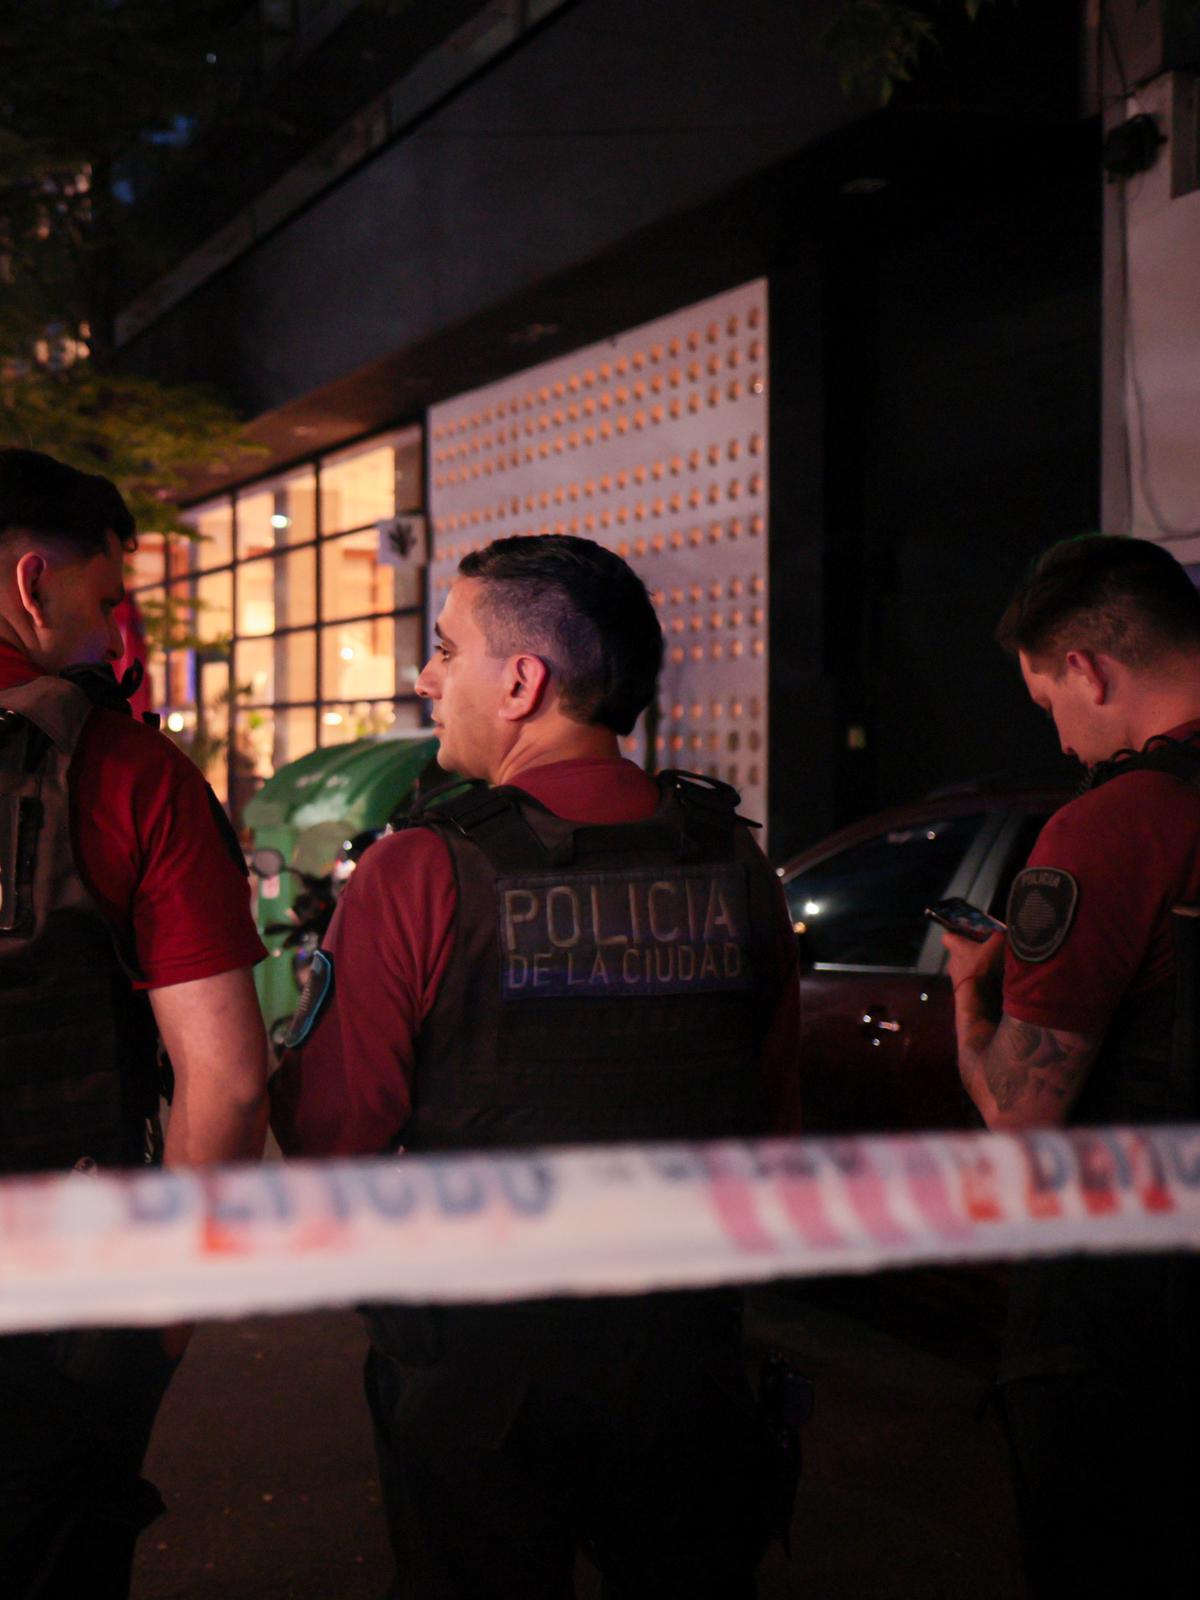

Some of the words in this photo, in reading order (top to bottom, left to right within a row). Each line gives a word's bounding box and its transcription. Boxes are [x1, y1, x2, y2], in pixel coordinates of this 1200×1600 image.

[504, 879, 738, 950] POLICIA
[508, 952, 553, 989] DE
[567, 948, 611, 985] LA
[622, 942, 742, 984] CIUDAD
